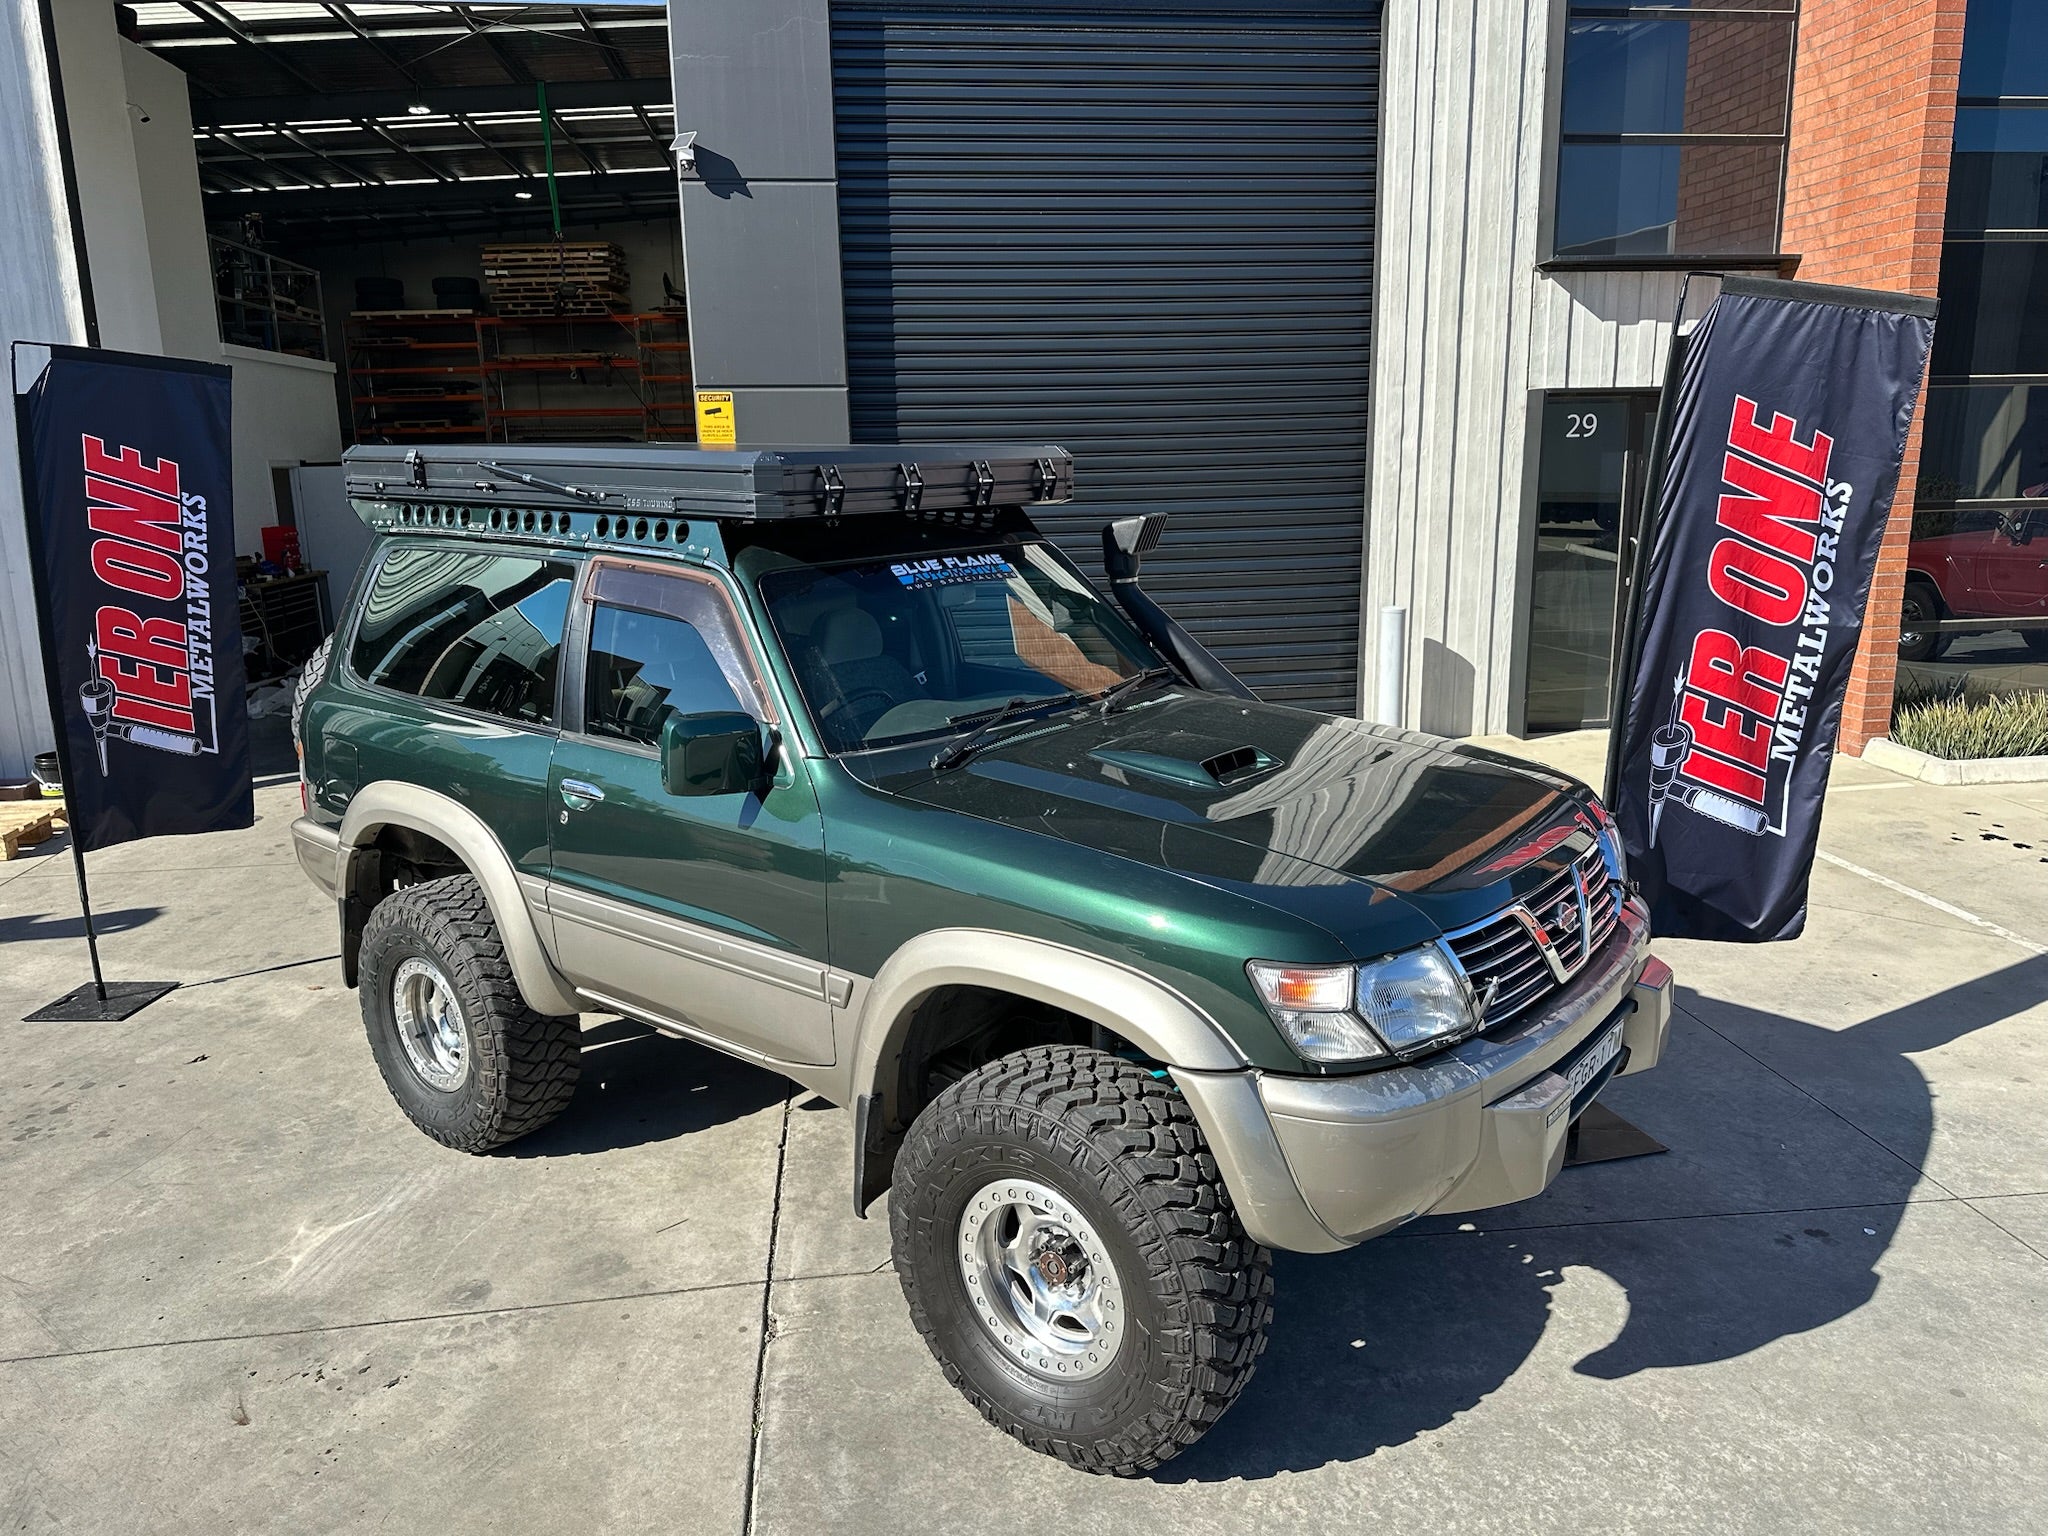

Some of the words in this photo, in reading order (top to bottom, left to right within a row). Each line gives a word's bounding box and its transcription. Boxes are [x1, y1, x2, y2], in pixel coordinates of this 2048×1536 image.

[700, 394, 730, 402] SECURITY
[1566, 413, 1597, 438] 29
[81, 432, 185, 601] ONE
[890, 559, 942, 577] BLUE
[942, 553, 1005, 569] FLAME
[1707, 393, 1835, 628] ONE
[181, 491, 215, 701] METALWORKS
[1771, 477, 1854, 761] METALWORKS
